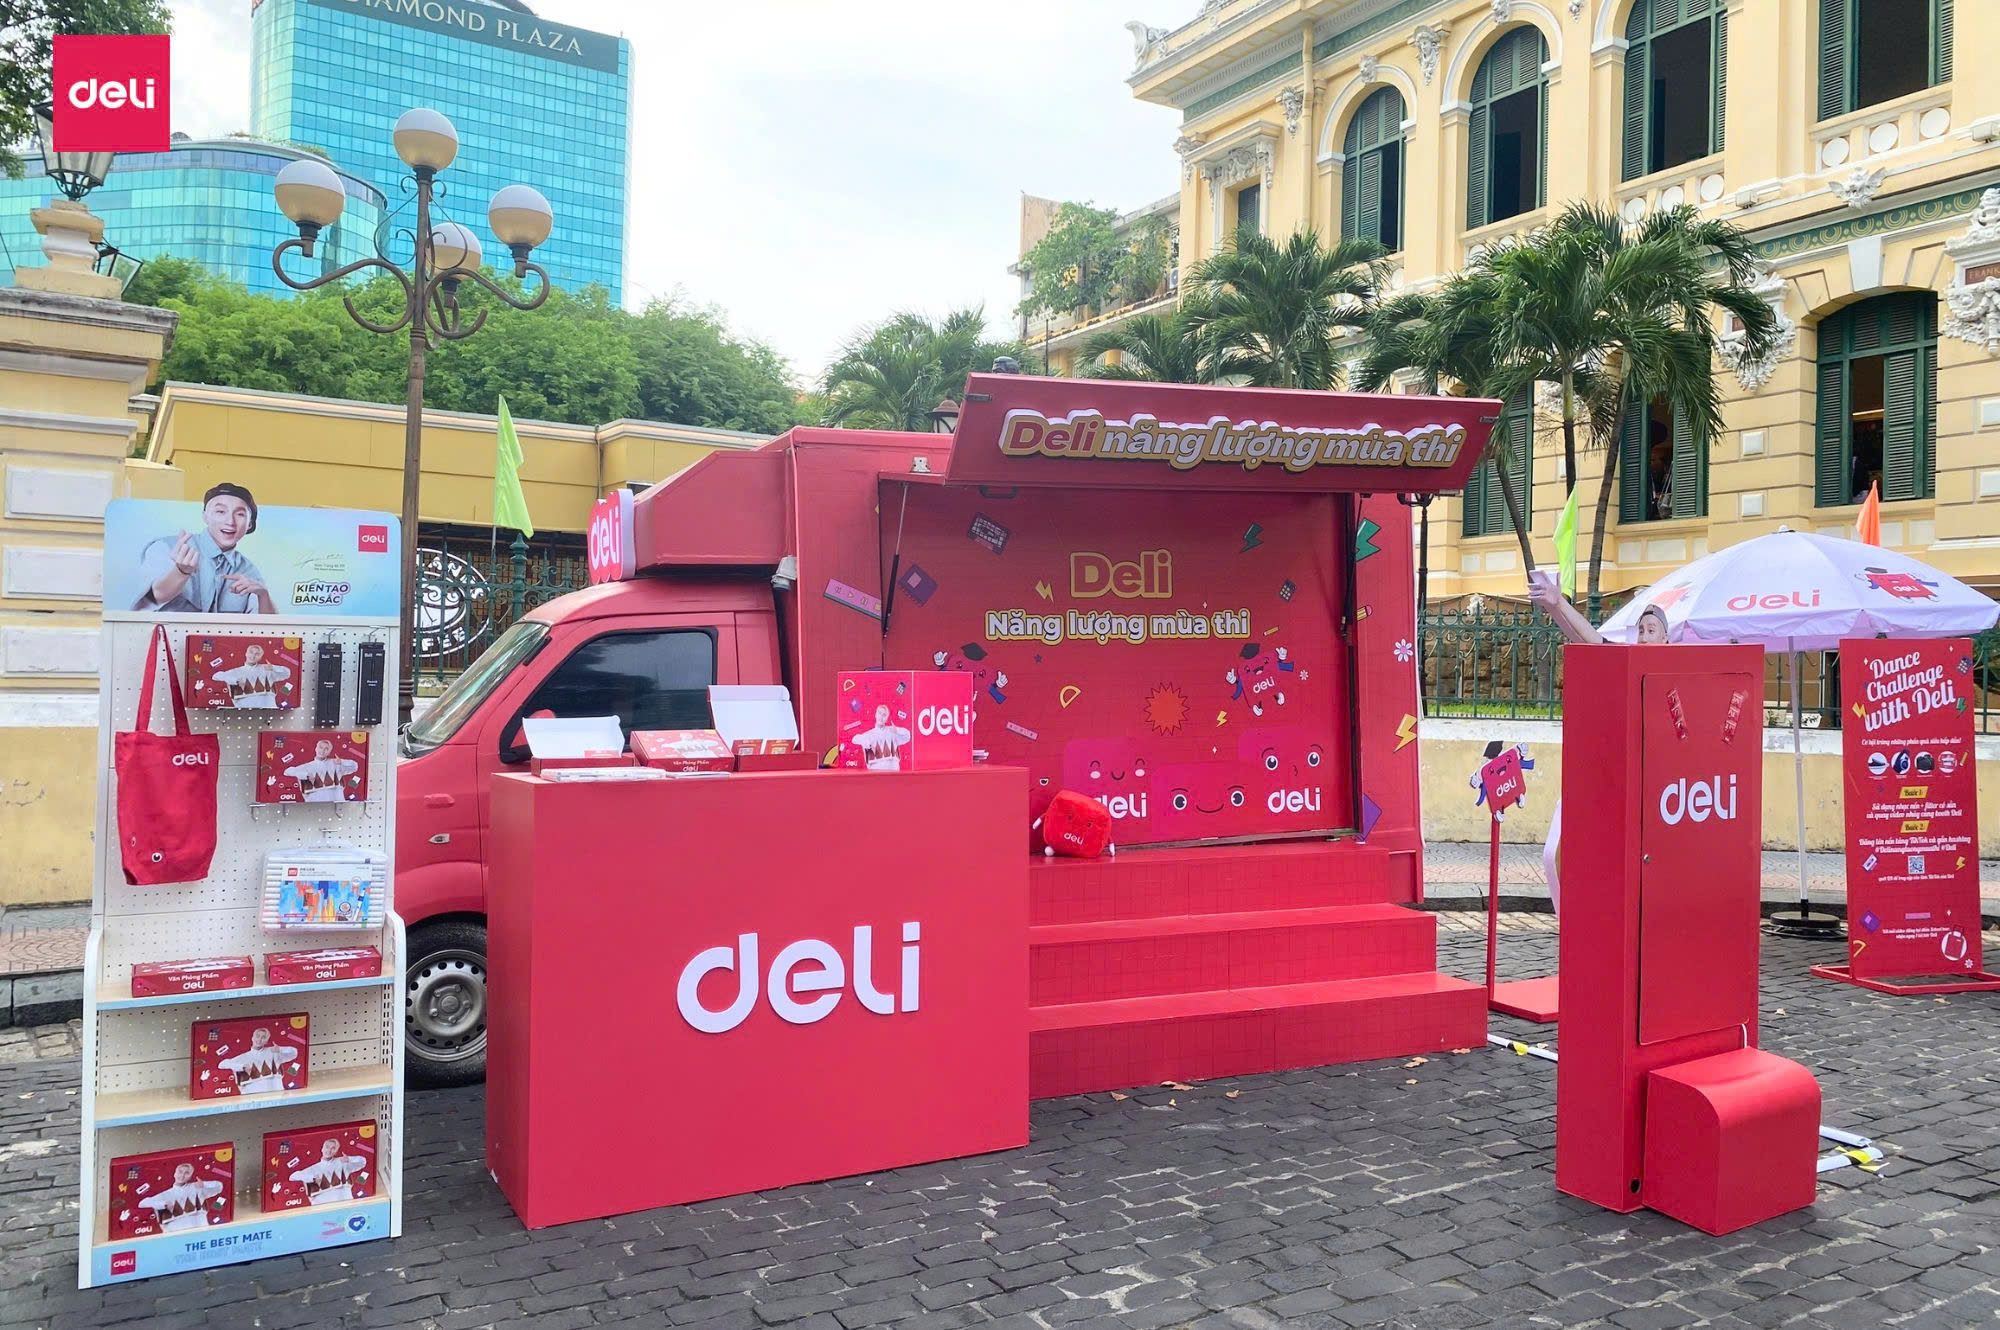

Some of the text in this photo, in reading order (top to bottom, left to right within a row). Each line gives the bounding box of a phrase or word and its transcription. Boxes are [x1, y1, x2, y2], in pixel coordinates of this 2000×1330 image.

[345, 0, 584, 56] AMOND PLAZA
[1007, 418, 1099, 452] Deli
[1100, 424, 1206, 465] năng
[1208, 425, 1321, 466] lượng
[1410, 432, 1463, 463] thi
[361, 534, 385, 544] deli
[590, 505, 620, 571] deli
[1072, 550, 1171, 597] Deli
[1727, 589, 1820, 613] deli
[986, 608, 1249, 642] Năng lượng mùa thi
[1869, 651, 1921, 680] Dance
[1252, 676, 1276, 694] deli
[1866, 664, 1944, 702] Challenge
[1864, 679, 1957, 732] with Deli
[917, 705, 969, 736] deli
[172, 752, 209, 766] deli
[280, 793, 297, 801] deli
[1495, 776, 1518, 797] deli
[1267, 787, 1322, 814] deli
[1660, 774, 1737, 825] deli
[1063, 831, 1085, 846] deli
[183, 980, 206, 990] deli
[315, 969, 337, 979] deli
[676, 921, 921, 1034] deli
[214, 1086, 232, 1095] deli
[285, 1198, 302, 1207] deli
[134, 1225, 153, 1235] deli
[185, 1229, 272, 1252] THE BEST MATE
[112, 1257, 135, 1268] deli
